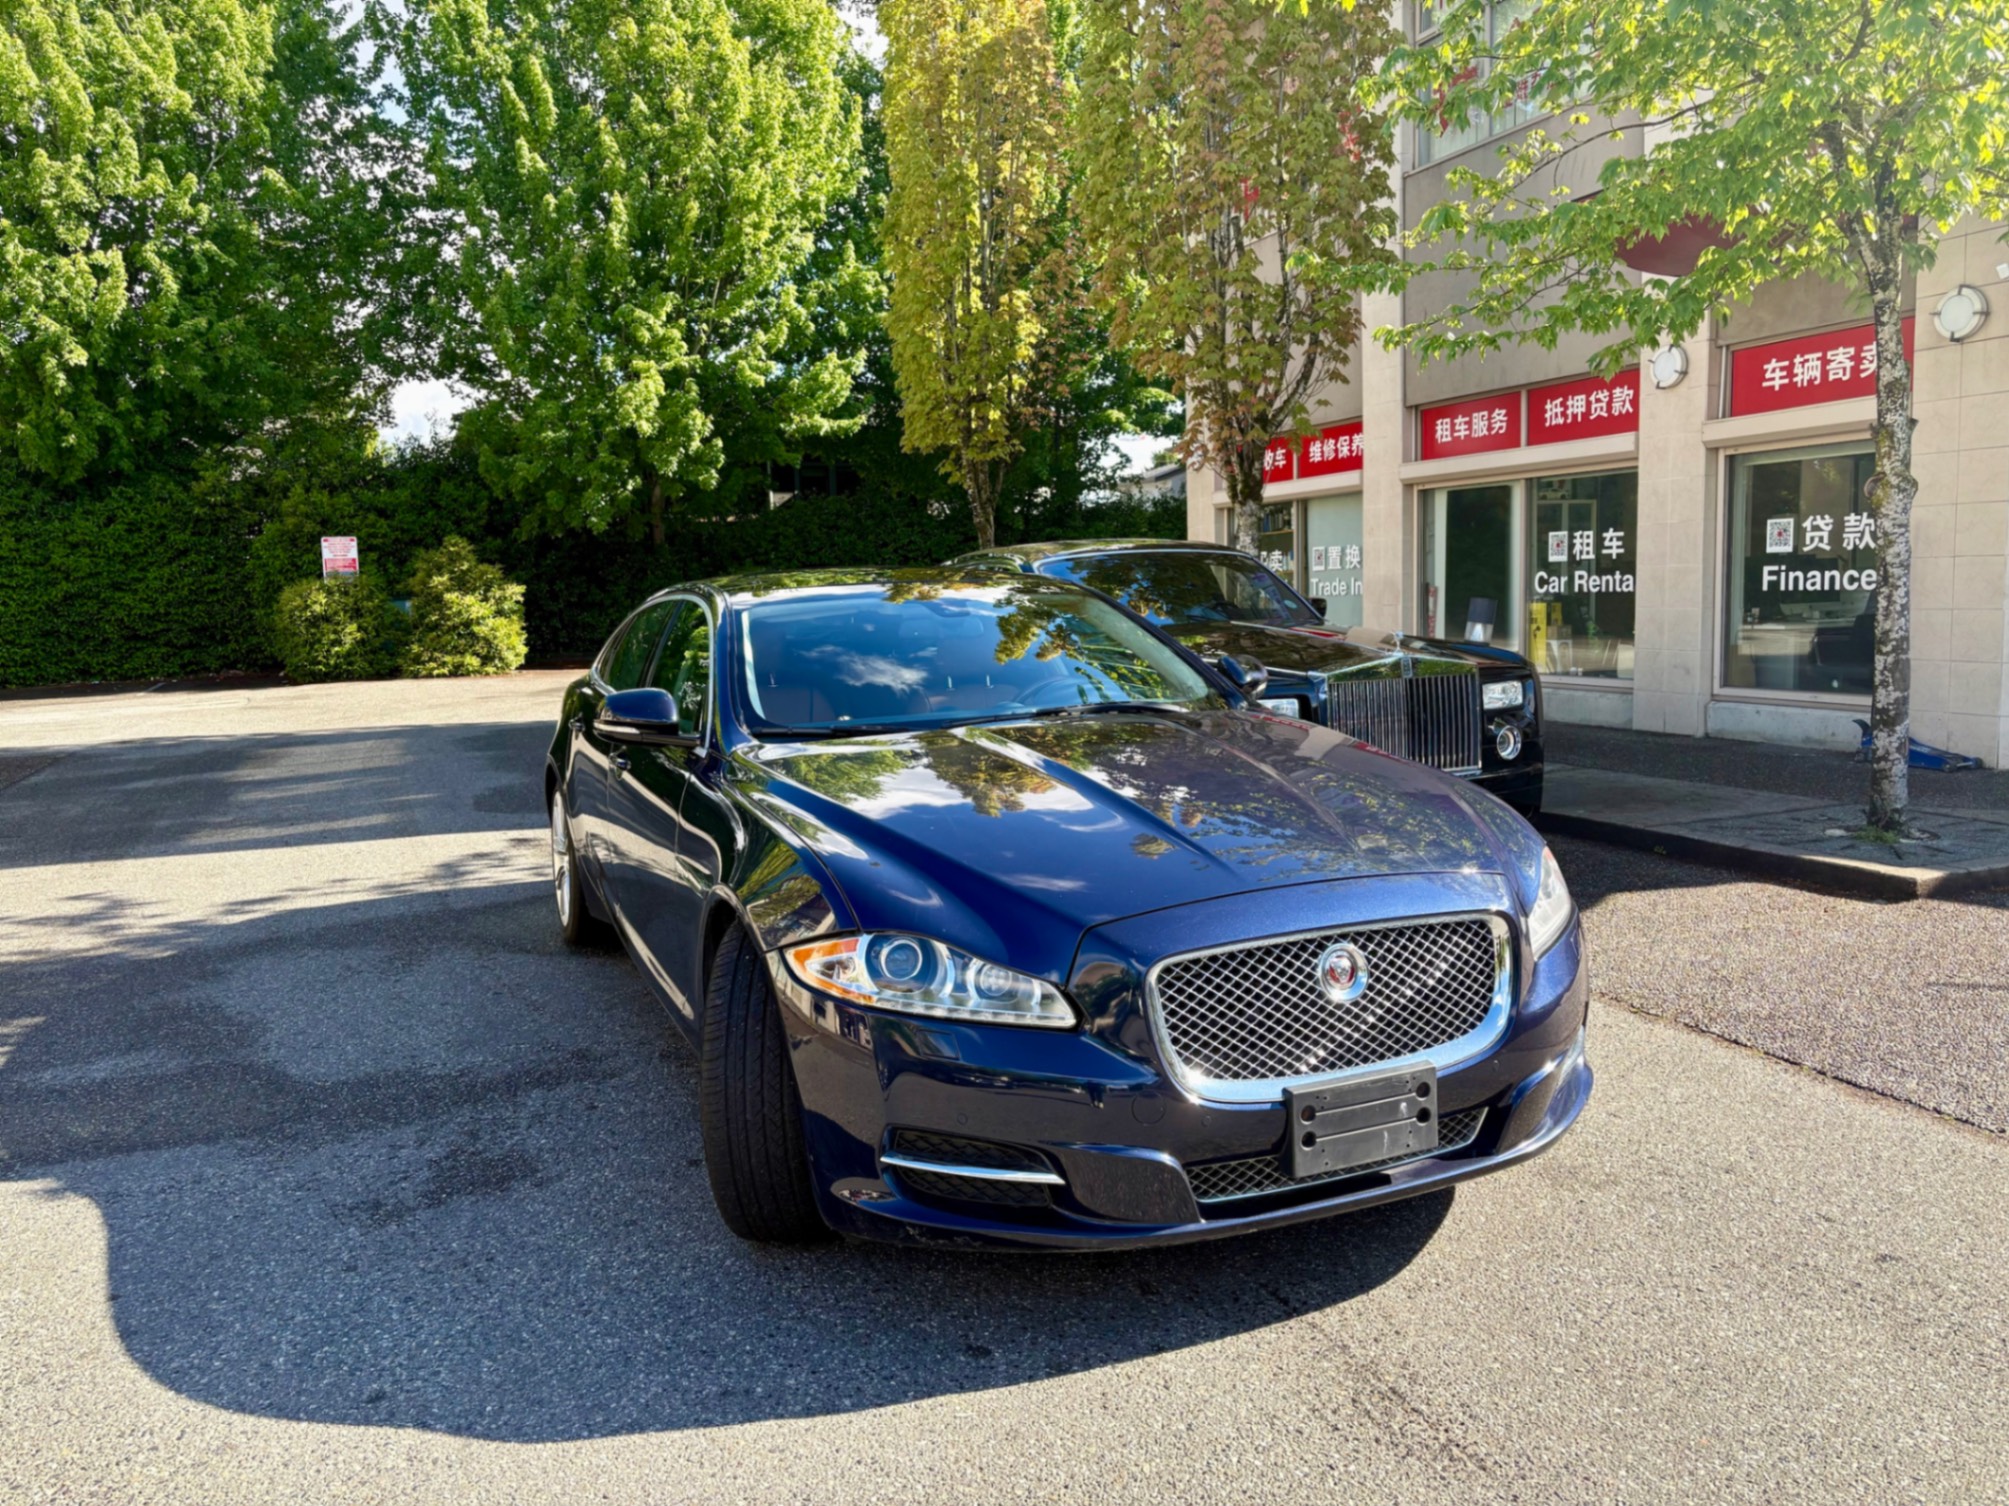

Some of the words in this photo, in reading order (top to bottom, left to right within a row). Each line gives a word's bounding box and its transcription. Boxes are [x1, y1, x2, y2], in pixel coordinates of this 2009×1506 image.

[1544, 384, 1634, 427] 抵押贷款
[1435, 408, 1508, 443] 租车服务
[1573, 527, 1624, 561] 租车
[1802, 512, 1876, 552] 贷款
[1327, 544, 1361, 570] 置换
[1311, 577, 1347, 596] Trade
[1351, 576, 1363, 596] In
[1535, 571, 1567, 593] Car
[1762, 564, 1877, 591] Finance
